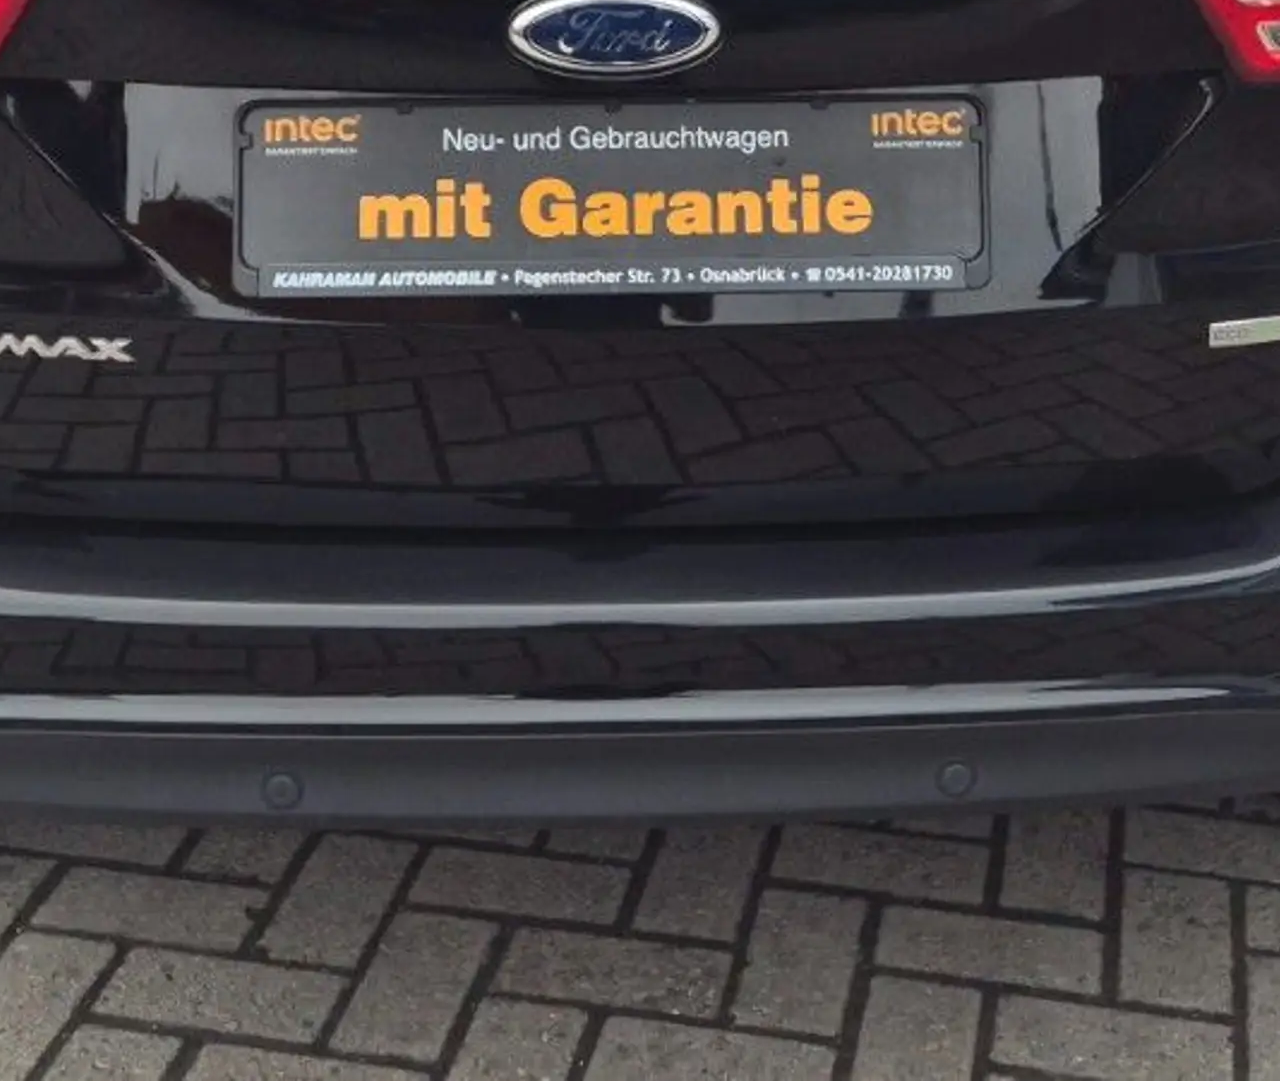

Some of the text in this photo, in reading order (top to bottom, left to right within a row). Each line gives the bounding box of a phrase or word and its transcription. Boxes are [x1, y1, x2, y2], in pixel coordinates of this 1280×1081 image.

[558, 9, 673, 54] Ford
[264, 114, 362, 143] intec
[872, 109, 966, 136] intec
[442, 125, 789, 154] Neu- und Gebrauchtwagen
[358, 174, 874, 240] mit Garantie
[273, 271, 375, 288] KAHRAMAN
[378, 270, 496, 287] AUTOMOBILE
[628, 270, 655, 283] Str.
[661, 269, 681, 283] 73
[700, 268, 786, 284] Osnabrück
[825, 264, 953, 281] 0541-20281730
